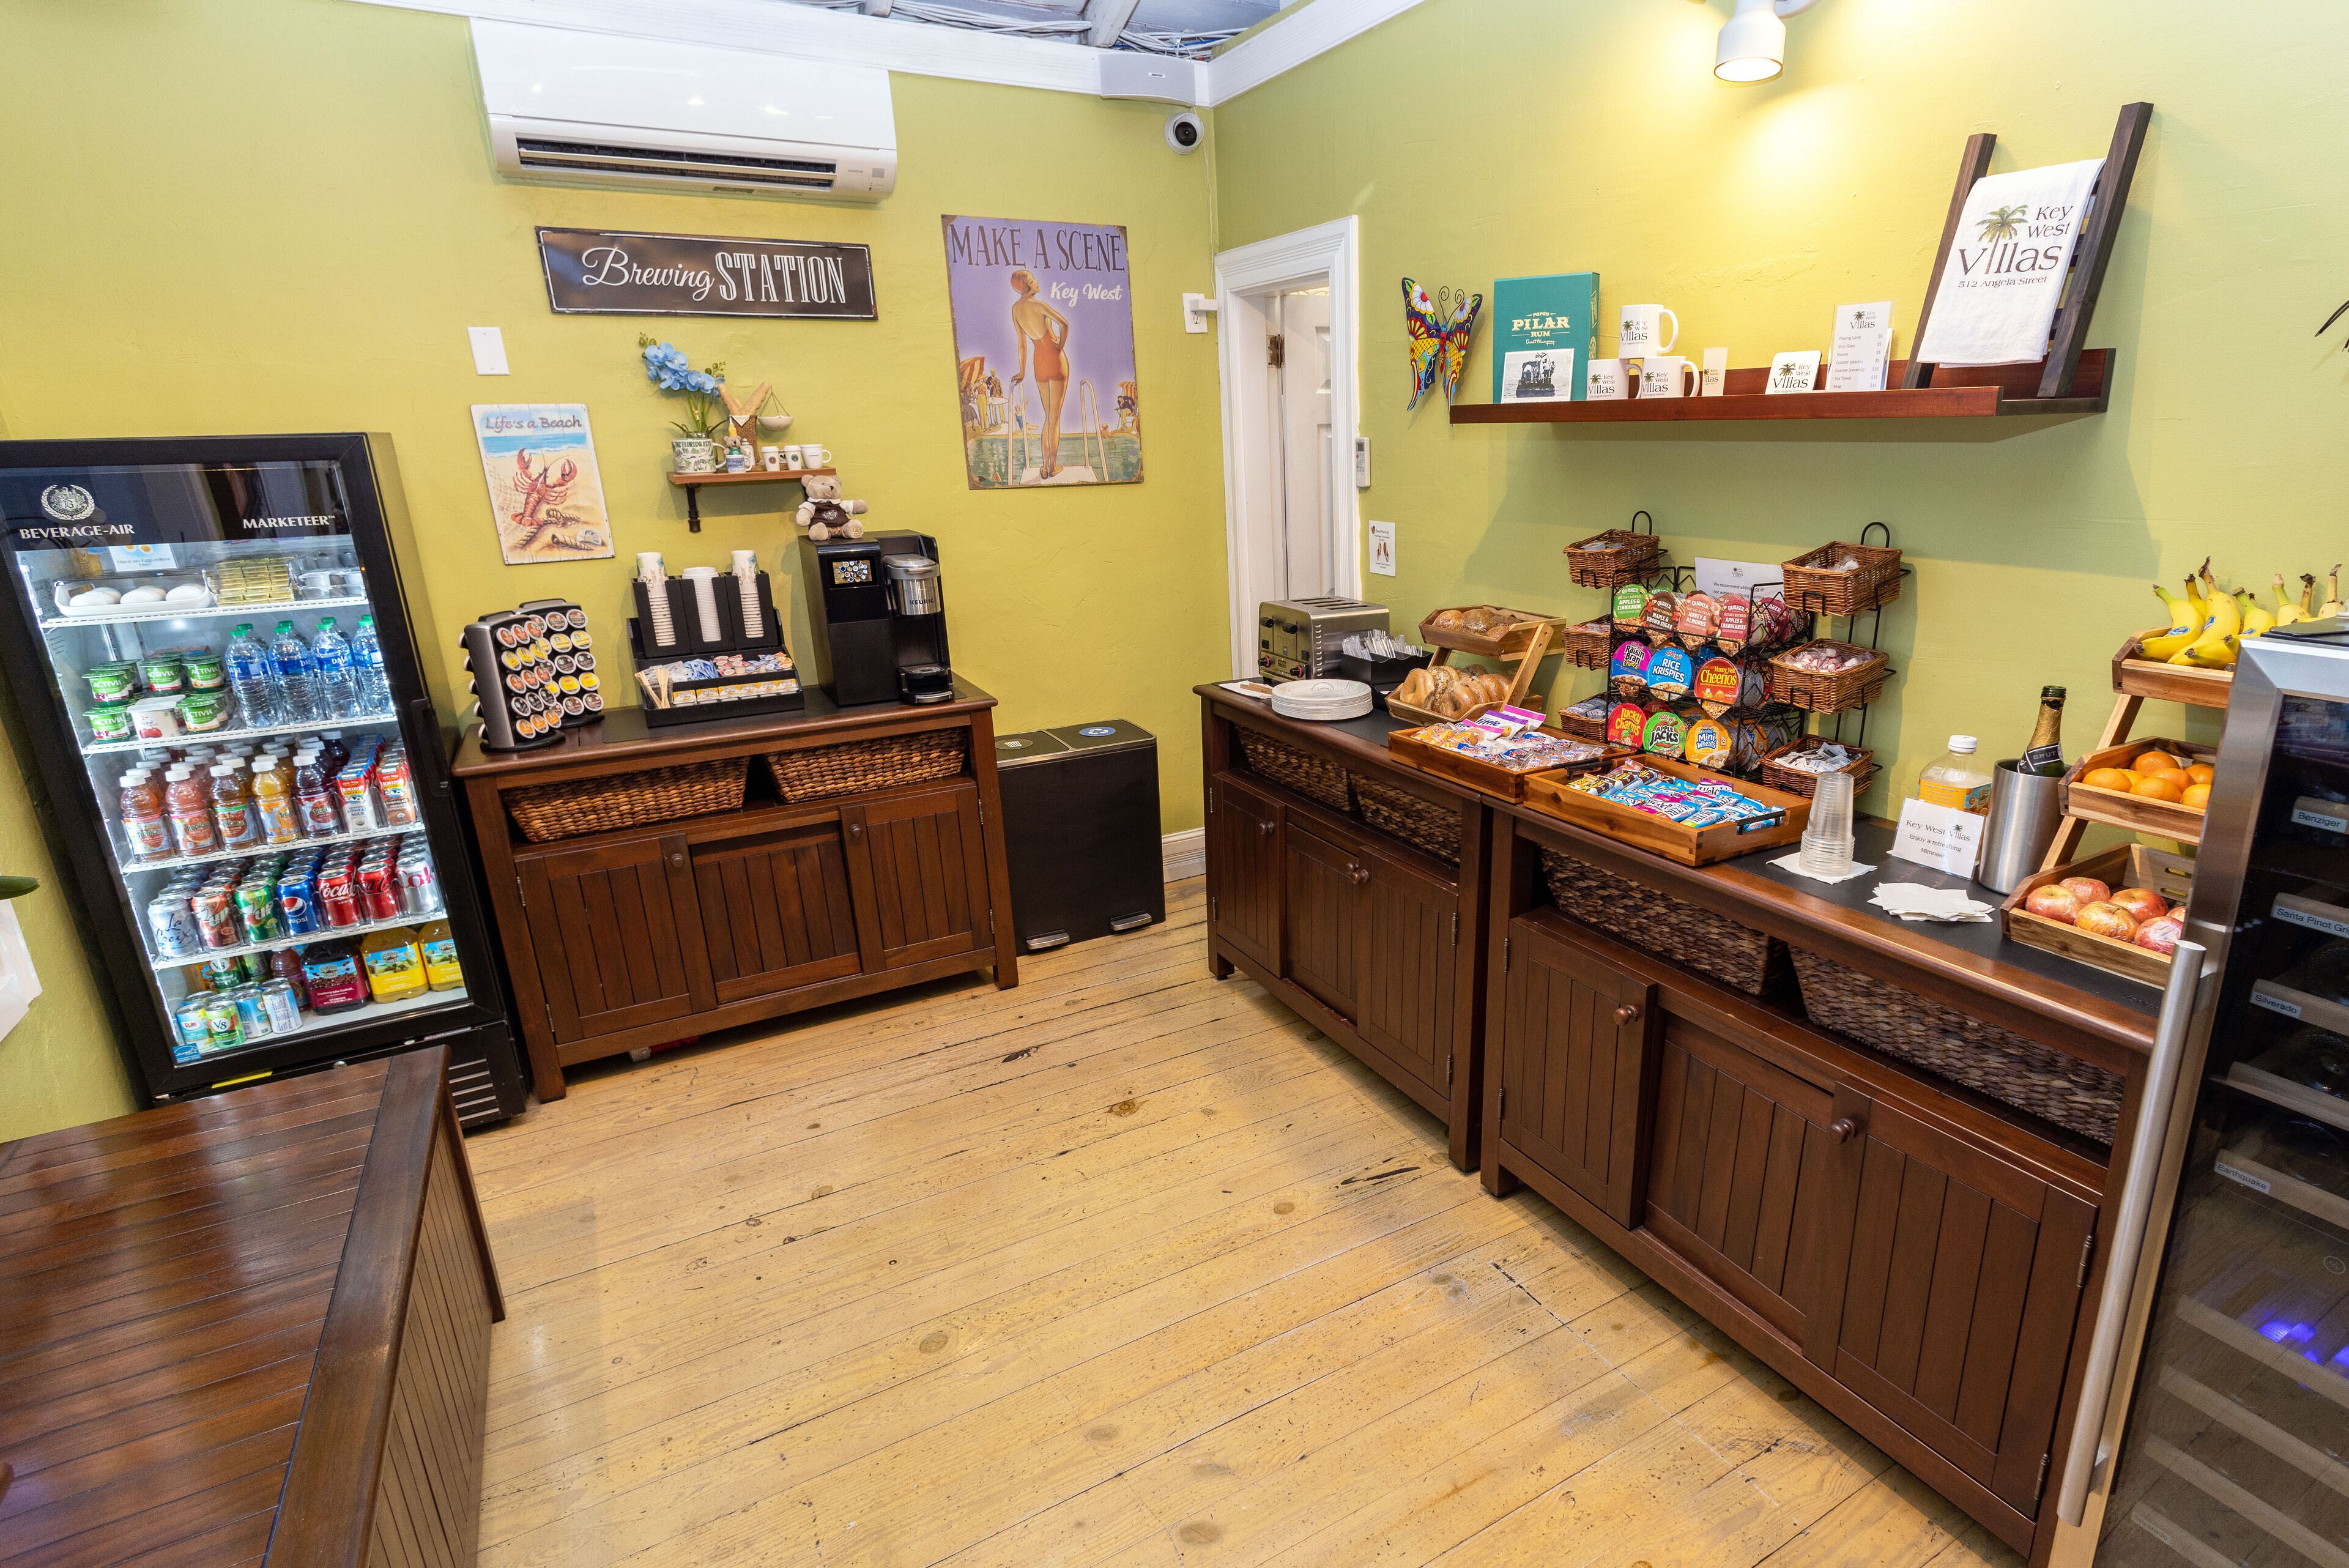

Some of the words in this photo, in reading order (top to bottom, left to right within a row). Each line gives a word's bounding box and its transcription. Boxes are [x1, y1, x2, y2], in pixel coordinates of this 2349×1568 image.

[2035, 206, 2073, 221] Key
[2028, 222, 2071, 239] West
[949, 224, 1026, 268] MAKE
[1034, 229, 1051, 269] A
[1056, 229, 1125, 273] SCENE
[1958, 242, 2063, 276] Villas
[582, 247, 715, 301] Brewing
[714, 251, 846, 304] STATION
[1980, 278, 2016, 288] Angela
[2018, 276, 2047, 284] Street
[1050, 282, 1078, 307] Key
[1083, 284, 1123, 300] West
[1512, 316, 1570, 331] PILAR
[1850, 320, 1875, 329] Villas
[1620, 332, 1647, 341] Villas
[1589, 385, 1615, 394] Villas
[1642, 384, 1668, 393] Villas
[1773, 377, 1808, 388] Villas
[486, 416, 523, 433] Life's
[539, 415, 582, 428] Beach
[20, 524, 135, 539] BEVERAGE-AIR
[1657, 601, 1671, 609] QUAKER
[1692, 601, 1709, 609] QUAKER
[1647, 617, 1660, 626] BROWN
[1661, 621, 1672, 630] SUGAR
[1653, 612, 1664, 621] MAPLE
[1686, 617, 1706, 626] ALMONDS
[1625, 645, 1645, 660] Raisin
[1625, 653, 1641, 665] Bran
[1623, 660, 1639, 669] Crunch
[1662, 658, 1681, 671] RICE
[1652, 665, 1685, 683] KRISPIES
[1701, 670, 1737, 685] Cheerios
[1616, 719, 1641, 735] Charms
[1649, 731, 1679, 749] JACKS
[1698, 733, 1716, 742] Mini
[2033, 751, 2056, 760] BRUT
[2298, 811, 2341, 828] Benziger
[1906, 820, 1923, 830] Key
[1925, 824, 1945, 835] West
[1909, 834, 1926, 844] Enjoy
[1932, 839, 1962, 852] refreshing
[2277, 908, 2304, 921] Santa
[2306, 916, 2331, 929] Pinot
[2255, 994, 2297, 1014] Silverado
[213, 1020, 226, 1029] V8
[2218, 1164, 2267, 1191] Earthquake
